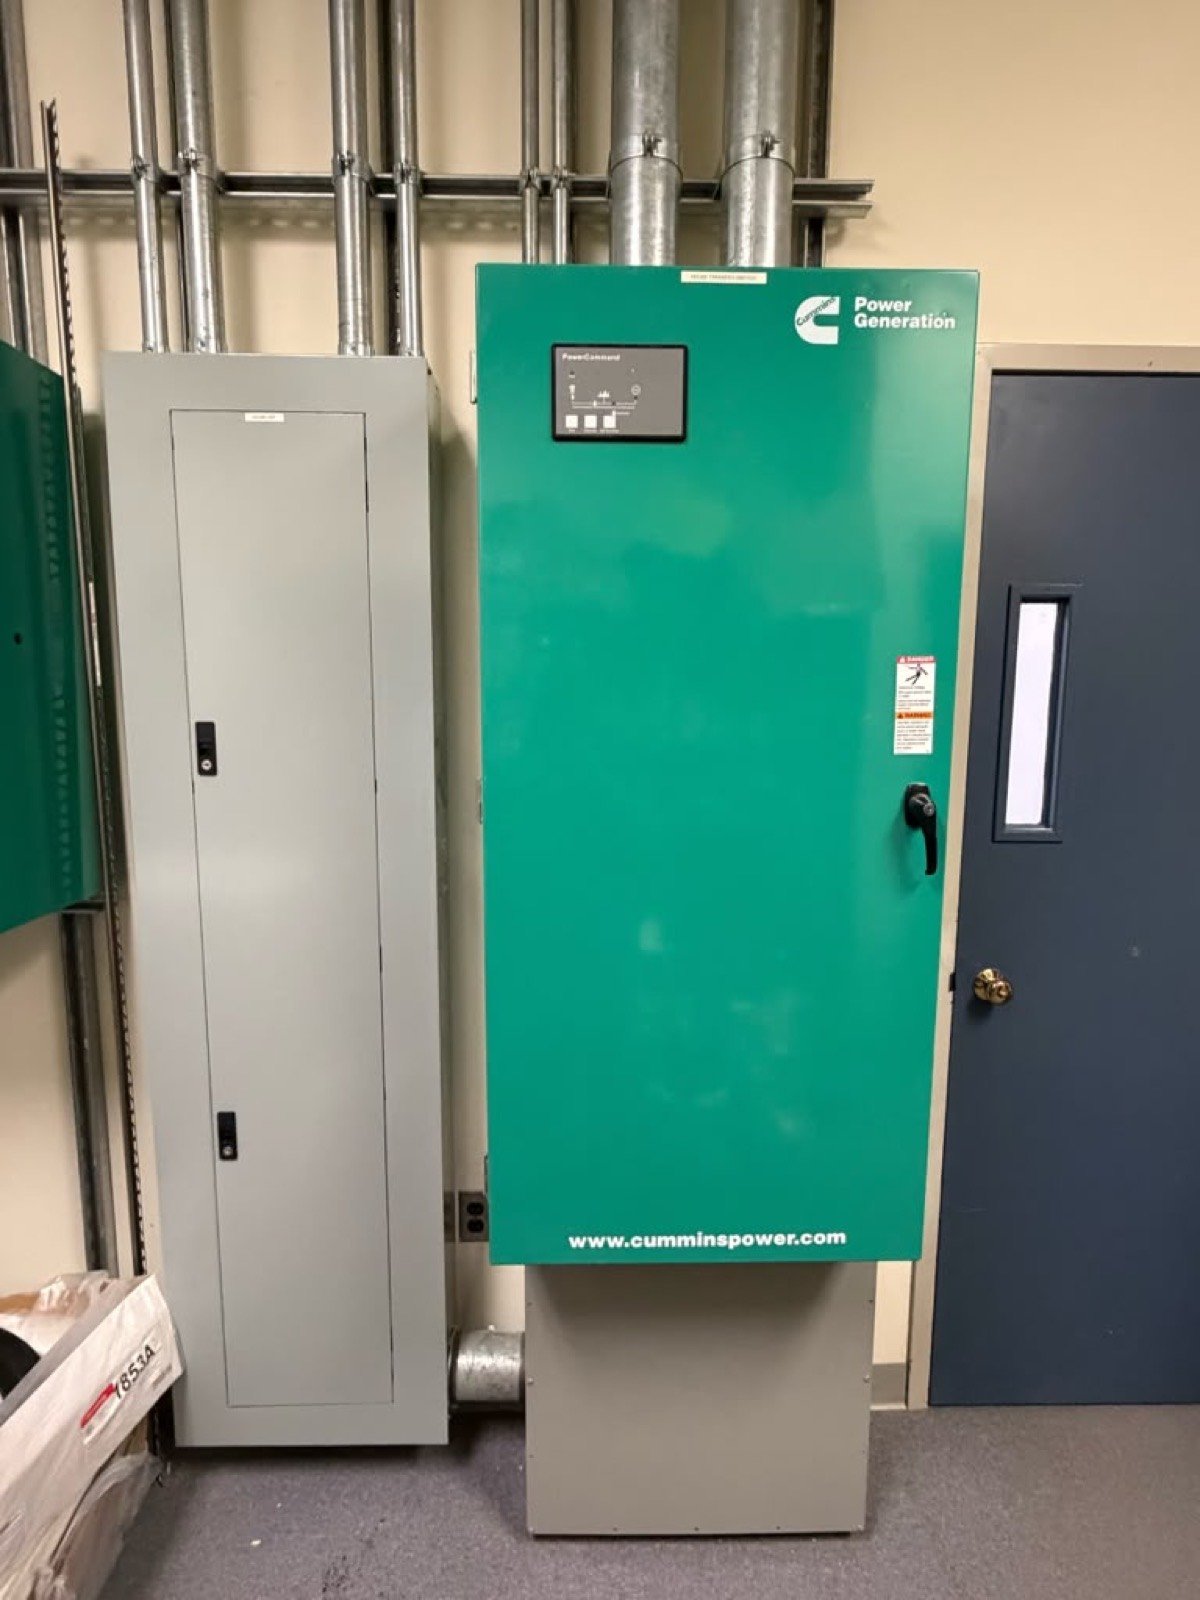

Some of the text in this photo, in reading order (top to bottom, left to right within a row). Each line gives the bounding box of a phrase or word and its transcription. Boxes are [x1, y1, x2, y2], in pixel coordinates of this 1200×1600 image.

[854, 296, 913, 312] Power
[853, 312, 956, 329] Generation
[567, 1230, 847, 1250] www.cumminspower.com
